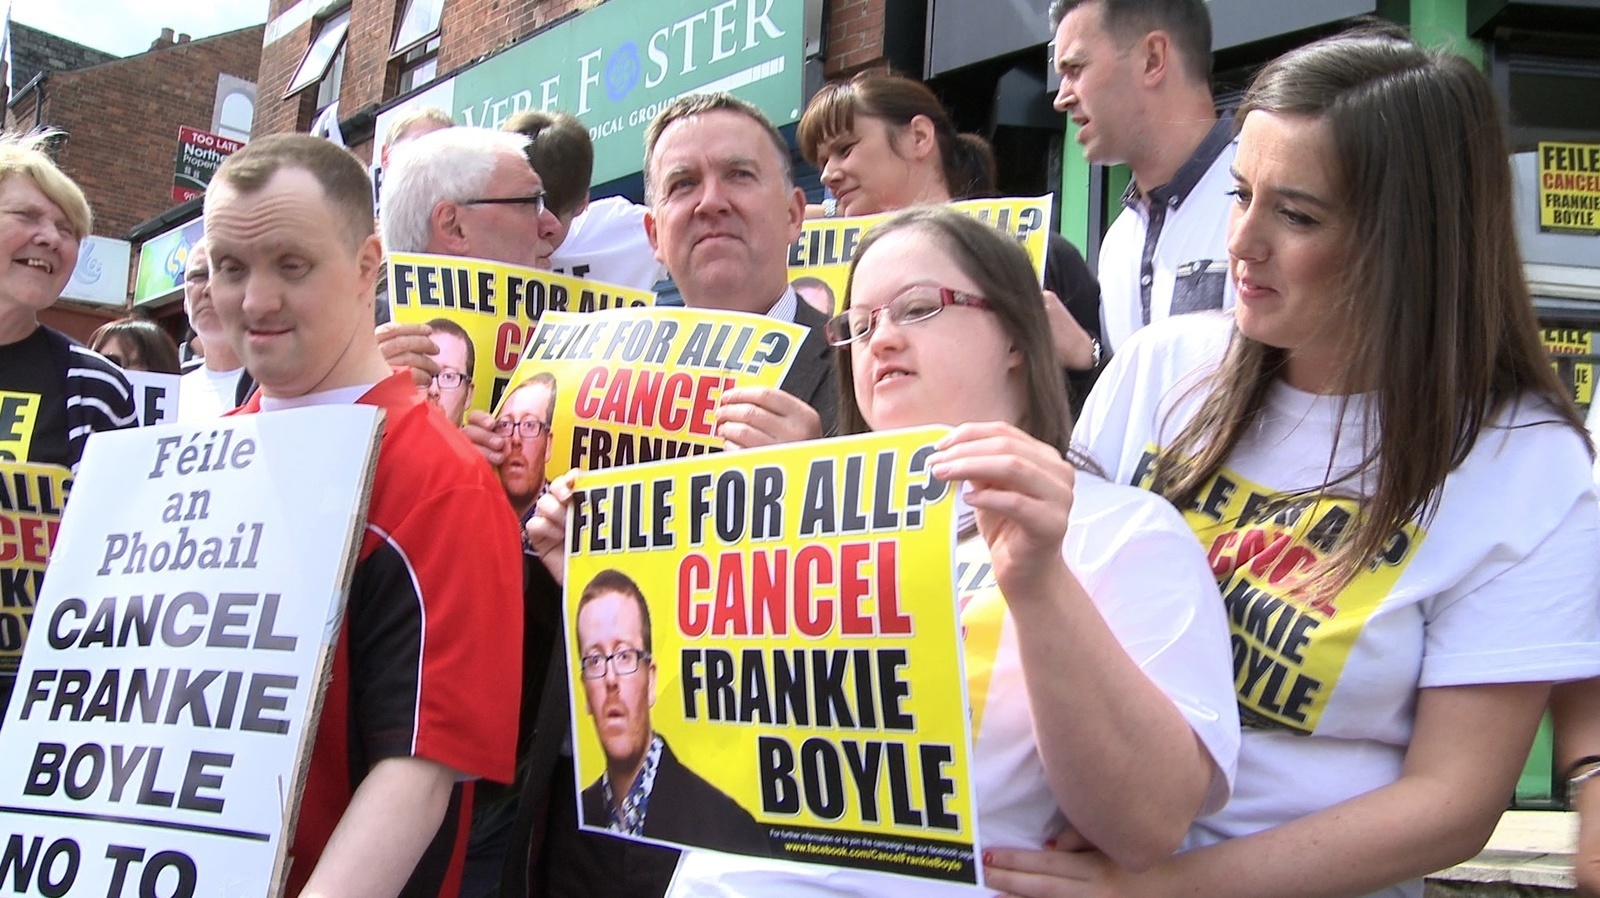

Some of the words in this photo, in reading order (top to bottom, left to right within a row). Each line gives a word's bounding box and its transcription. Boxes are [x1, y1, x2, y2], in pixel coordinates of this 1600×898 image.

[575, 0, 786, 117] FOSTER
[192, 131, 214, 146] TOO
[589, 116, 624, 141] DICAL
[183, 153, 219, 170] Propert
[1543, 145, 1600, 173] FEILE
[1553, 210, 1594, 226] BOYLE
[787, 226, 860, 268] EILE
[393, 264, 496, 314] FEILE
[507, 276, 568, 321] FOR
[526, 323, 609, 360] FEILE
[602, 320, 679, 365] FOR
[676, 322, 791, 374] ALL?
[148, 430, 256, 479] Féile
[162, 488, 211, 522] an
[570, 479, 674, 555] FEILE
[689, 466, 785, 543] FOR
[799, 444, 952, 536] ALL?
[97, 523, 264, 576] Phobail
[677, 541, 913, 638] CANCEL
[47, 592, 298, 652] CANCEL
[20, 668, 299, 735] FRANKIE
[680, 648, 915, 732] FRANKIE
[22, 742, 235, 814] BOYLE
[758, 735, 961, 833] BOYLE
[0, 834, 81, 898] NO
[104, 843, 198, 898] TO
